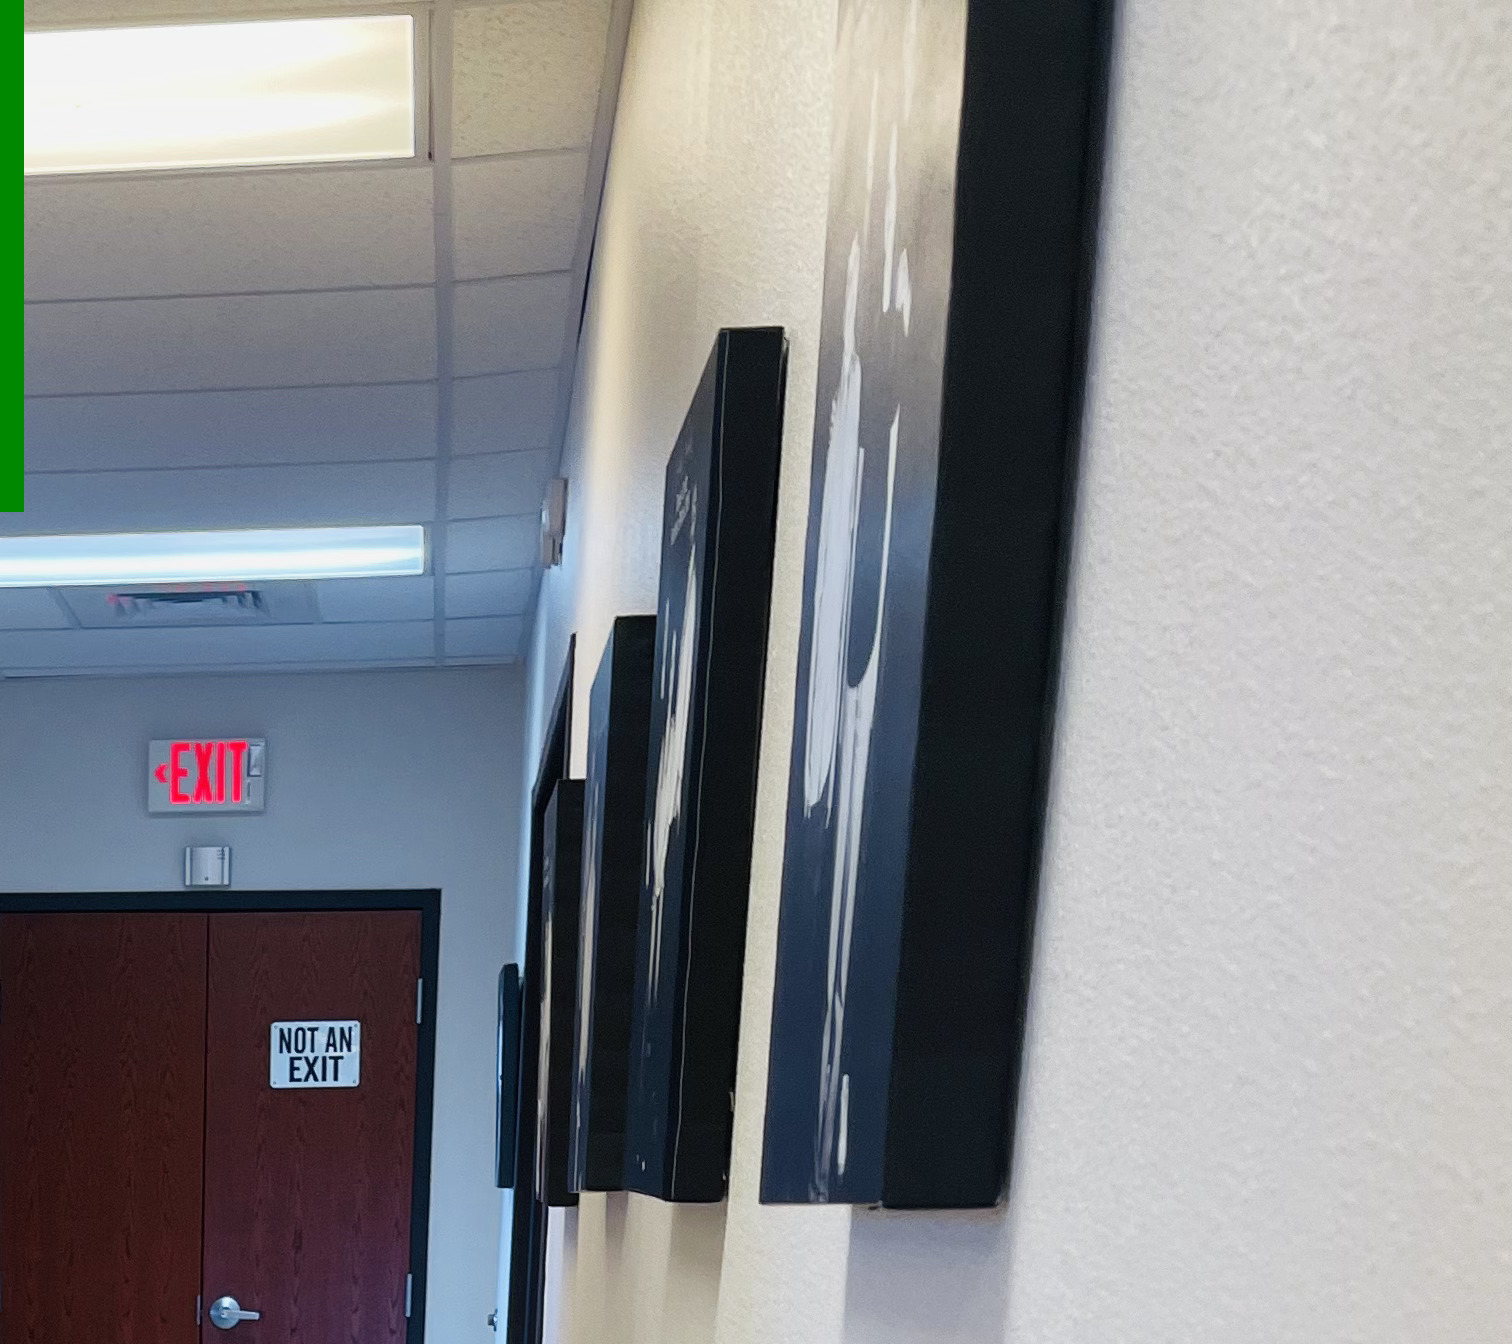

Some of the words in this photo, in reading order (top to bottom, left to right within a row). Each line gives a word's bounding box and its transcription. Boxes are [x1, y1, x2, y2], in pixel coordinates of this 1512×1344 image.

[170, 741, 248, 804] EXIT
[279, 1027, 319, 1053] NOT
[325, 1026, 352, 1052] AN
[289, 1055, 344, 1082] EXIT
